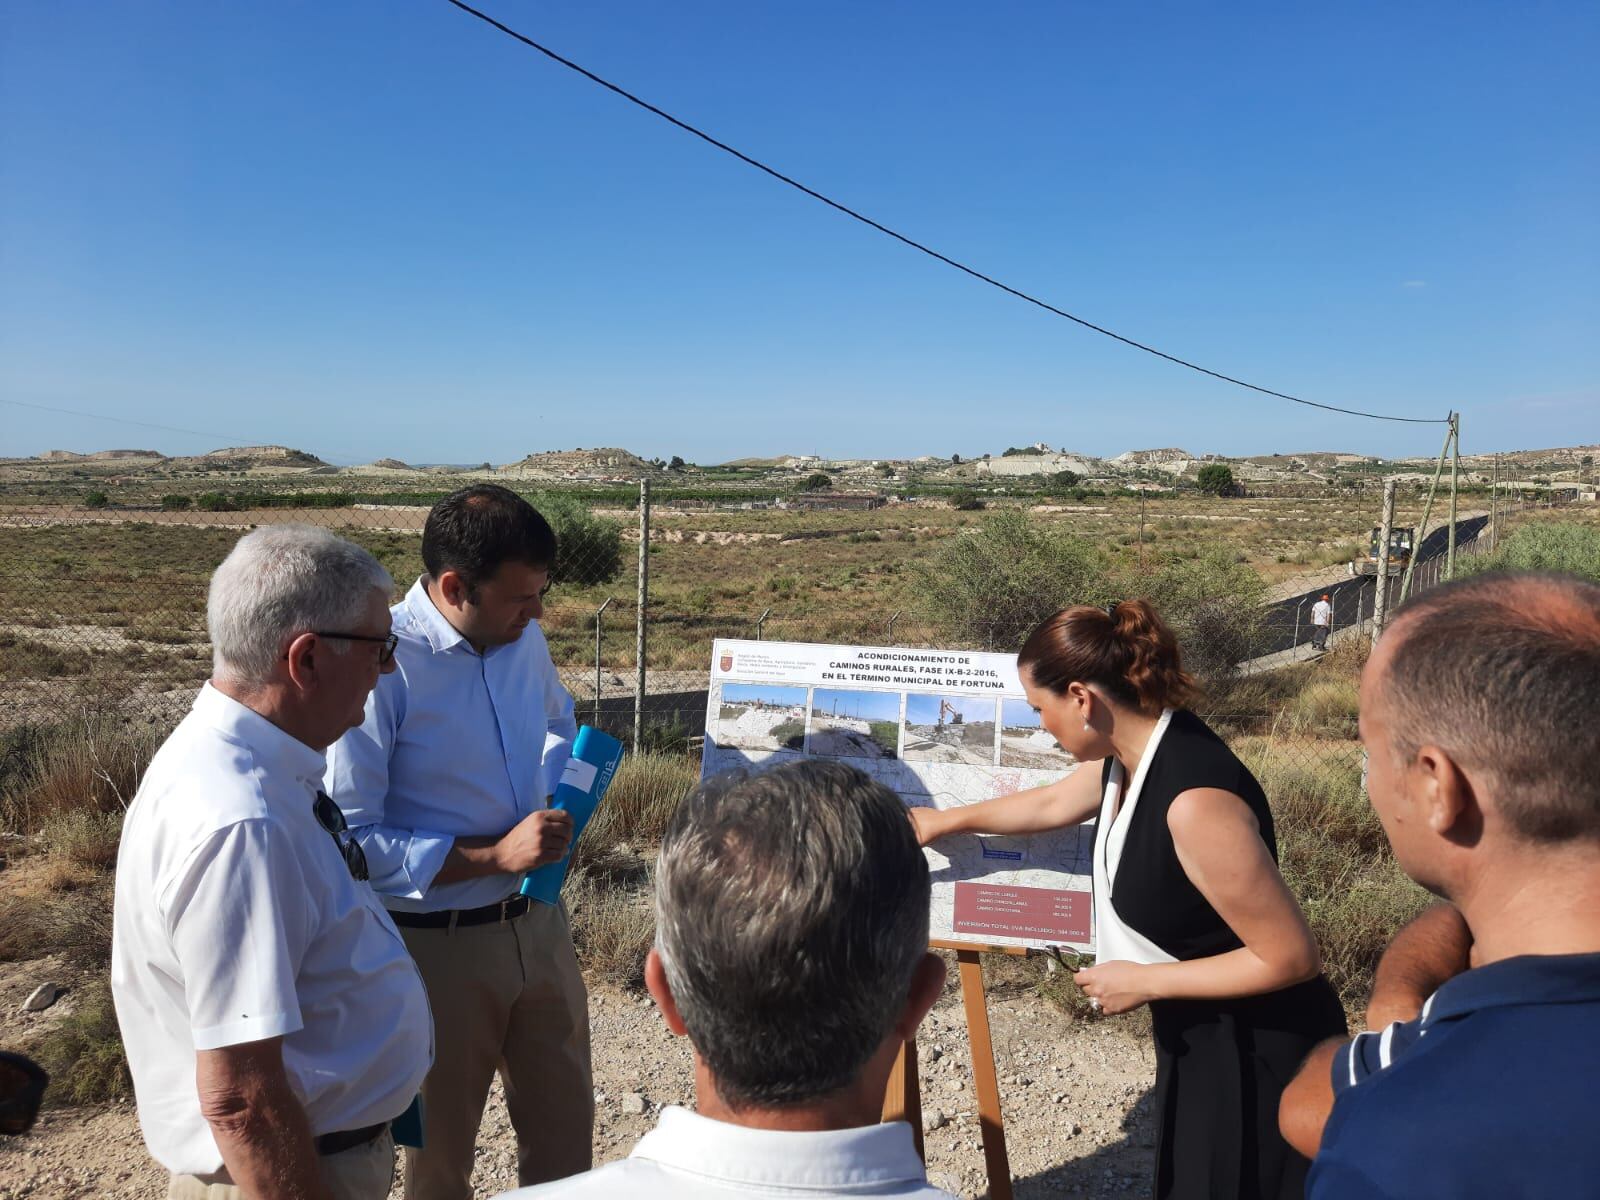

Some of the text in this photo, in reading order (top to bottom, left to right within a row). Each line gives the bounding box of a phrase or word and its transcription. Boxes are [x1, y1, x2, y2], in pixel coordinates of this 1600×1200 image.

[858, 652, 956, 664] ACONDICIONAMIENTO
[829, 662, 870, 670] CAMINOS
[872, 664, 917, 674] RURALES,
[945, 668, 998, 678] IX-B-2-2016,
[893, 676, 944, 686] MUNICIPAL
[960, 680, 1005, 688] FORTUNA
